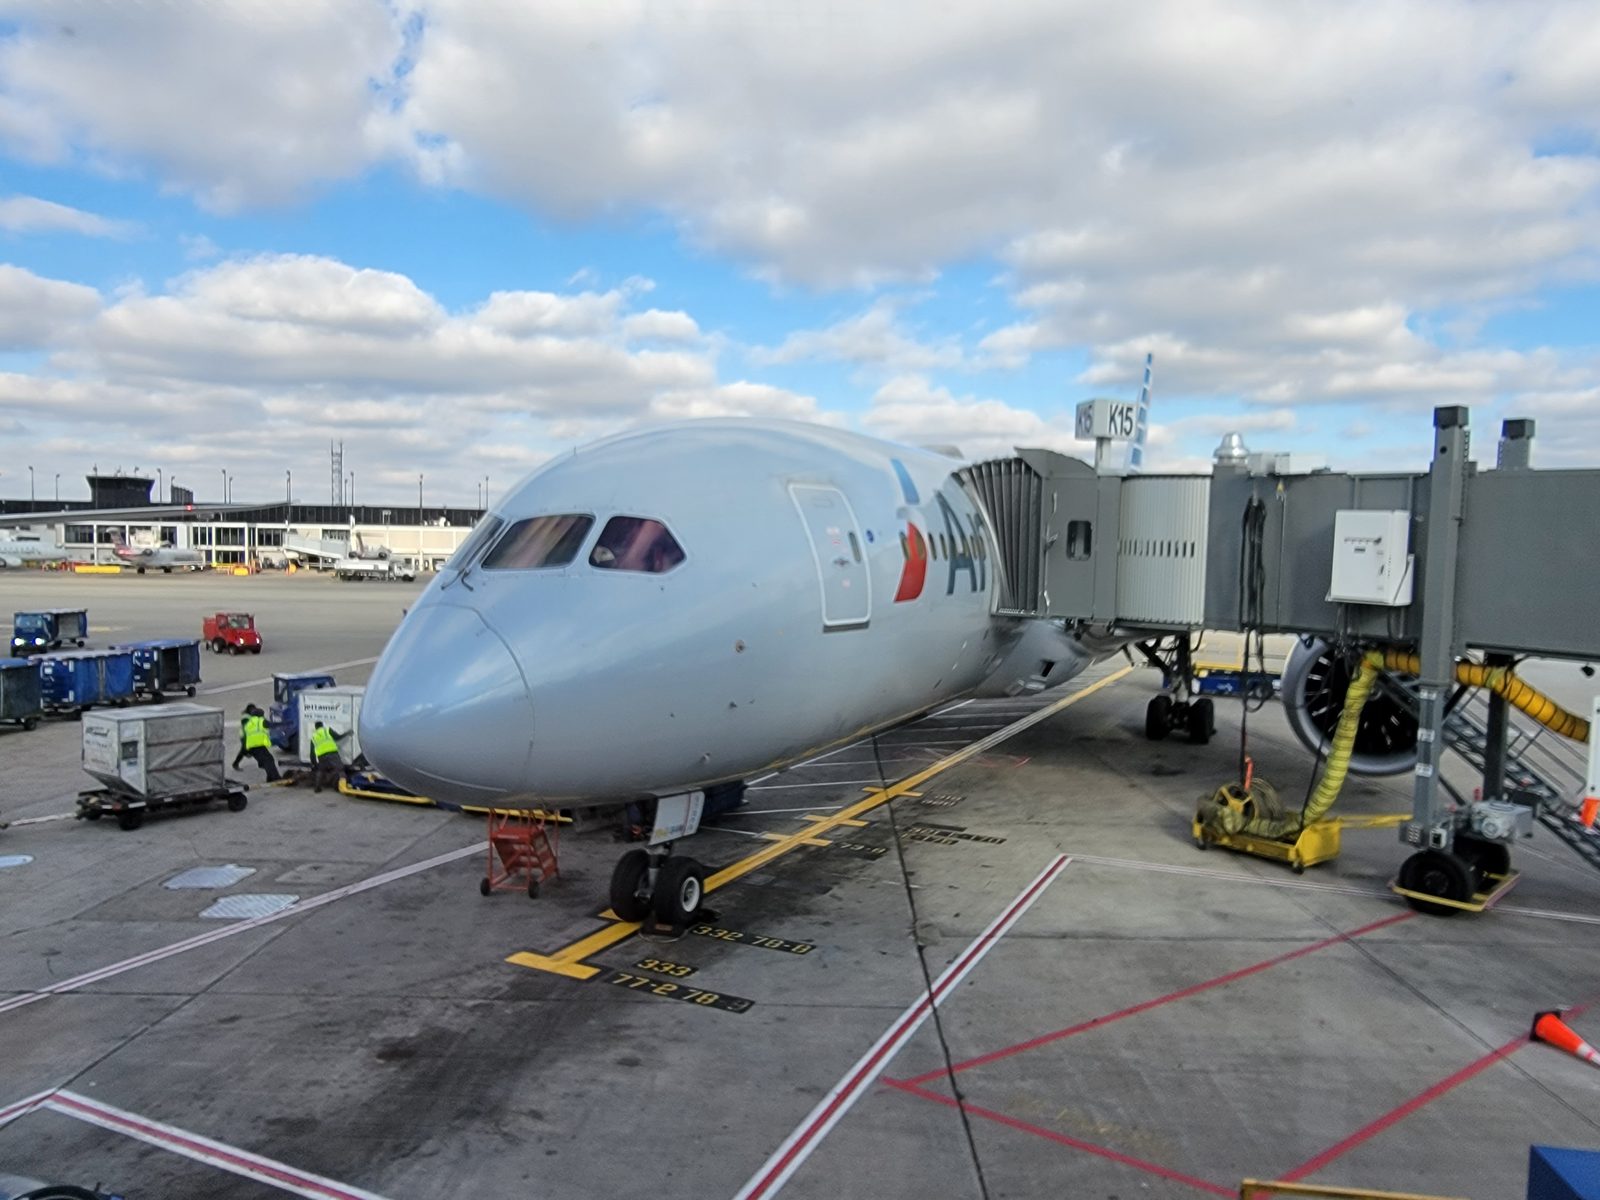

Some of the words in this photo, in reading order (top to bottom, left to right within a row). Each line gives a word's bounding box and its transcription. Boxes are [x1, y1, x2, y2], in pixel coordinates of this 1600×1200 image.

[1108, 404, 1133, 436] K15
[692, 925, 743, 941] 332
[637, 958, 692, 977] 333
[611, 972, 678, 996] 77-2
